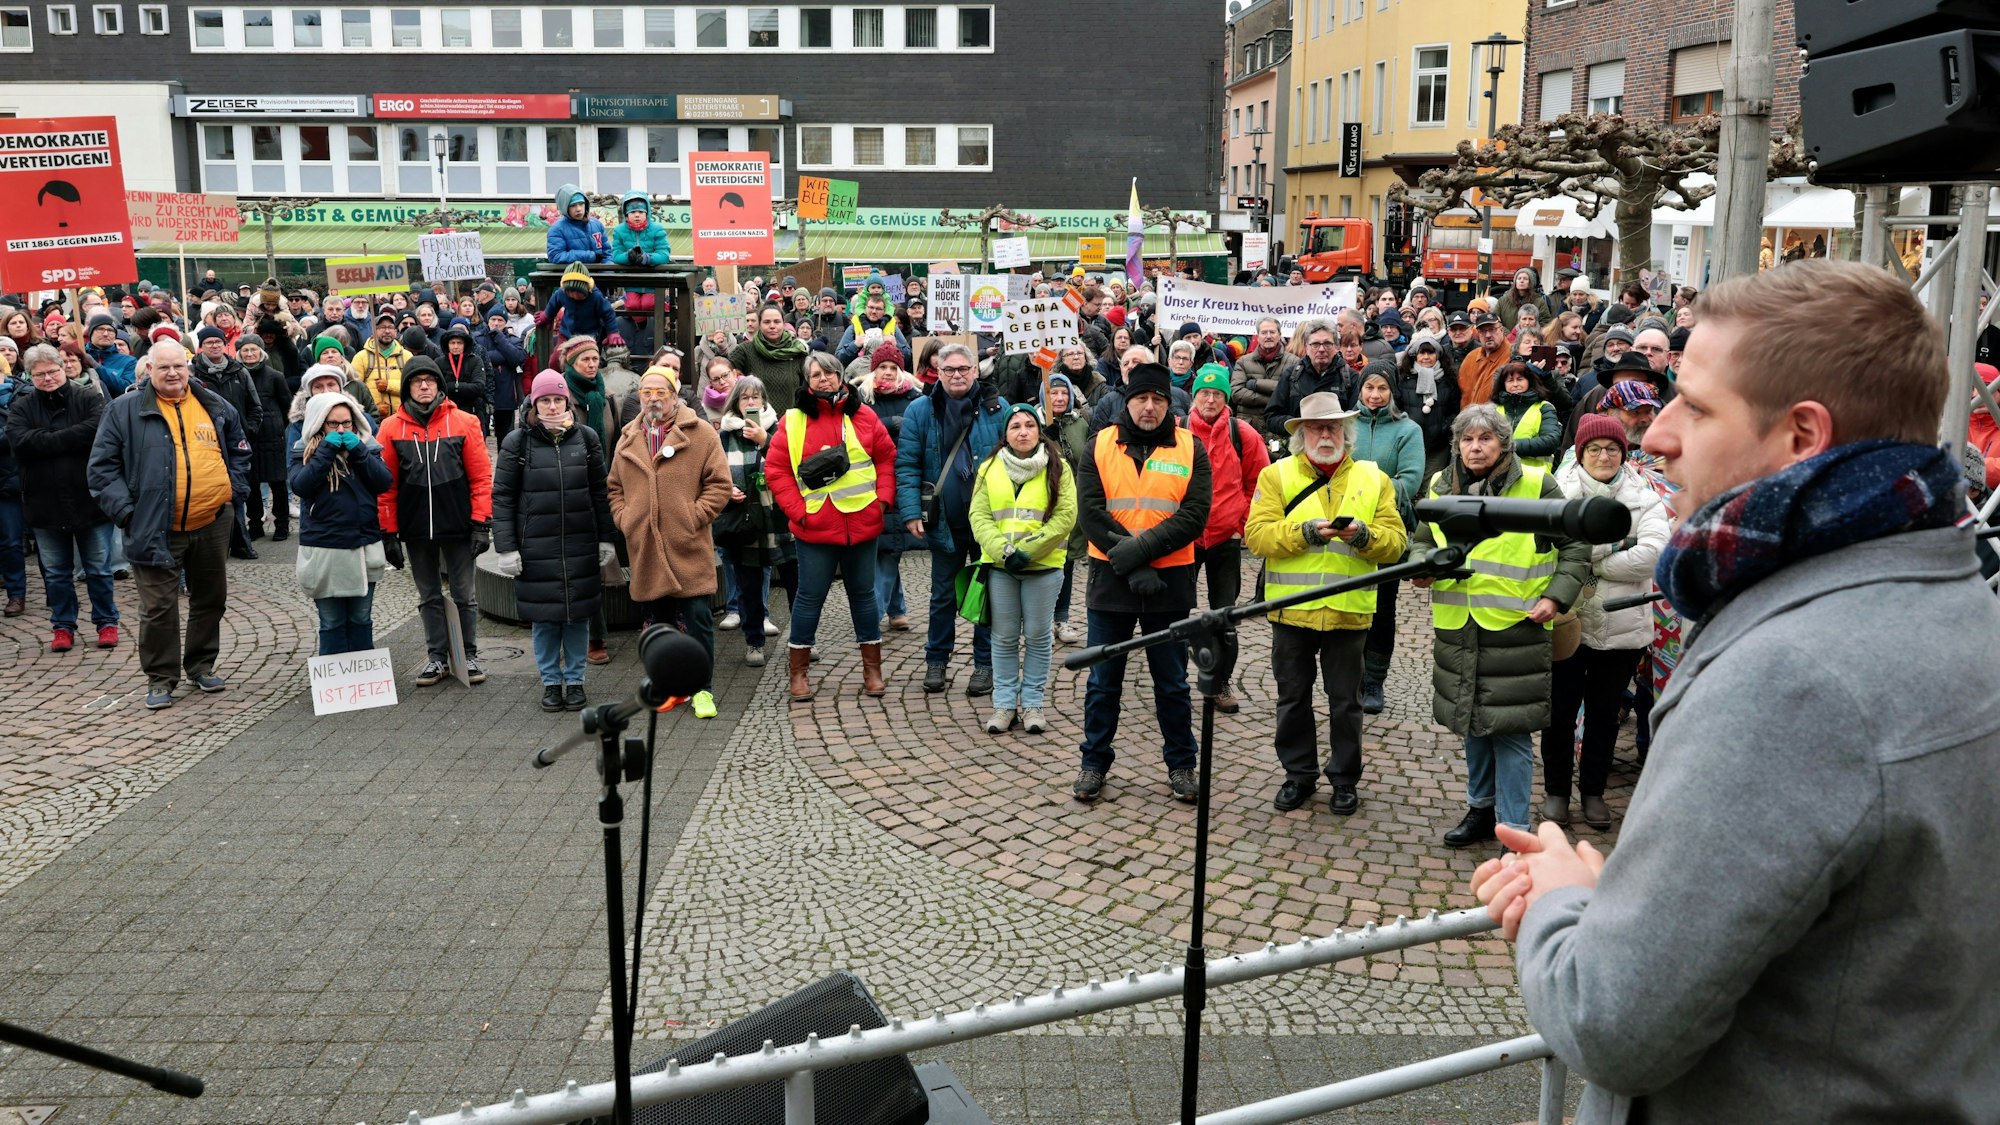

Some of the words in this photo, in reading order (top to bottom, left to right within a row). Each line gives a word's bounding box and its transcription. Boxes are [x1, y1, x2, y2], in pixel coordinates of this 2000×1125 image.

[190, 100, 258, 113] ZEIGER
[380, 100, 414, 111] ERGO
[590, 97, 668, 106] PHYSIOTHERAPIE
[590, 108, 624, 116] SINGER
[0, 132, 106, 149] DEMOKRATIE
[1350, 125, 1358, 148] KAMO
[0, 152, 109, 169] VERTEIDIGEN!
[696, 162, 763, 171] DEMOKRATIE
[698, 176, 763, 184] VERTEIDIGEN!
[806, 179, 830, 191] WIR
[156, 193, 207, 204] UNRECHT
[802, 190, 856, 208] BLEIBEN
[155, 204, 172, 216] ZU
[177, 206, 212, 218] RECHT
[280, 208, 326, 222] OBST
[332, 208, 346, 222] &
[824, 208, 854, 220] BUNT
[157, 218, 228, 230] WIDERSTAND
[856, 215, 865, 225] &
[870, 212, 926, 226] GEMÜSE
[1047, 217, 1099, 228] FLEISCH
[1103, 217, 1112, 228] &
[10, 241, 29, 249] SEIT
[32, 240, 54, 248] 1863
[57, 237, 88, 246] GEGEN
[90, 234, 120, 243] NAZIS.
[175, 230, 197, 241] ZUR
[201, 231, 239, 242] PFLICHT
[422, 236, 481, 253] FEMINISMUS
[717, 251, 737, 260] SPD
[41, 268, 76, 283] SPD
[427, 264, 484, 281] FASCHISMUS
[935, 277, 960, 289] BJÖRN
[935, 289, 960, 301] HÖCKE
[979, 295, 1001, 303] STIMME
[975, 301, 992, 309] GEGEN
[1020, 302, 1059, 314] OMA
[1164, 295, 1200, 308] Unser
[1202, 298, 1239, 311] Kreuz
[1242, 301, 1265, 313] hat
[1267, 304, 1304, 315] keine
[1307, 303, 1347, 315] Haken
[935, 307, 960, 321] NAZI
[983, 309, 996, 319] AFD
[1197, 314, 1211, 323] für
[1212, 316, 1257, 326] Demokrati
[1009, 319, 1072, 333] GEGEN
[1005, 336, 1078, 351] RECHTS
[313, 662, 336, 680] NIE
[338, 657, 389, 674] WIEDER
[319, 686, 345, 704] IST
[348, 679, 393, 704] JETZT
